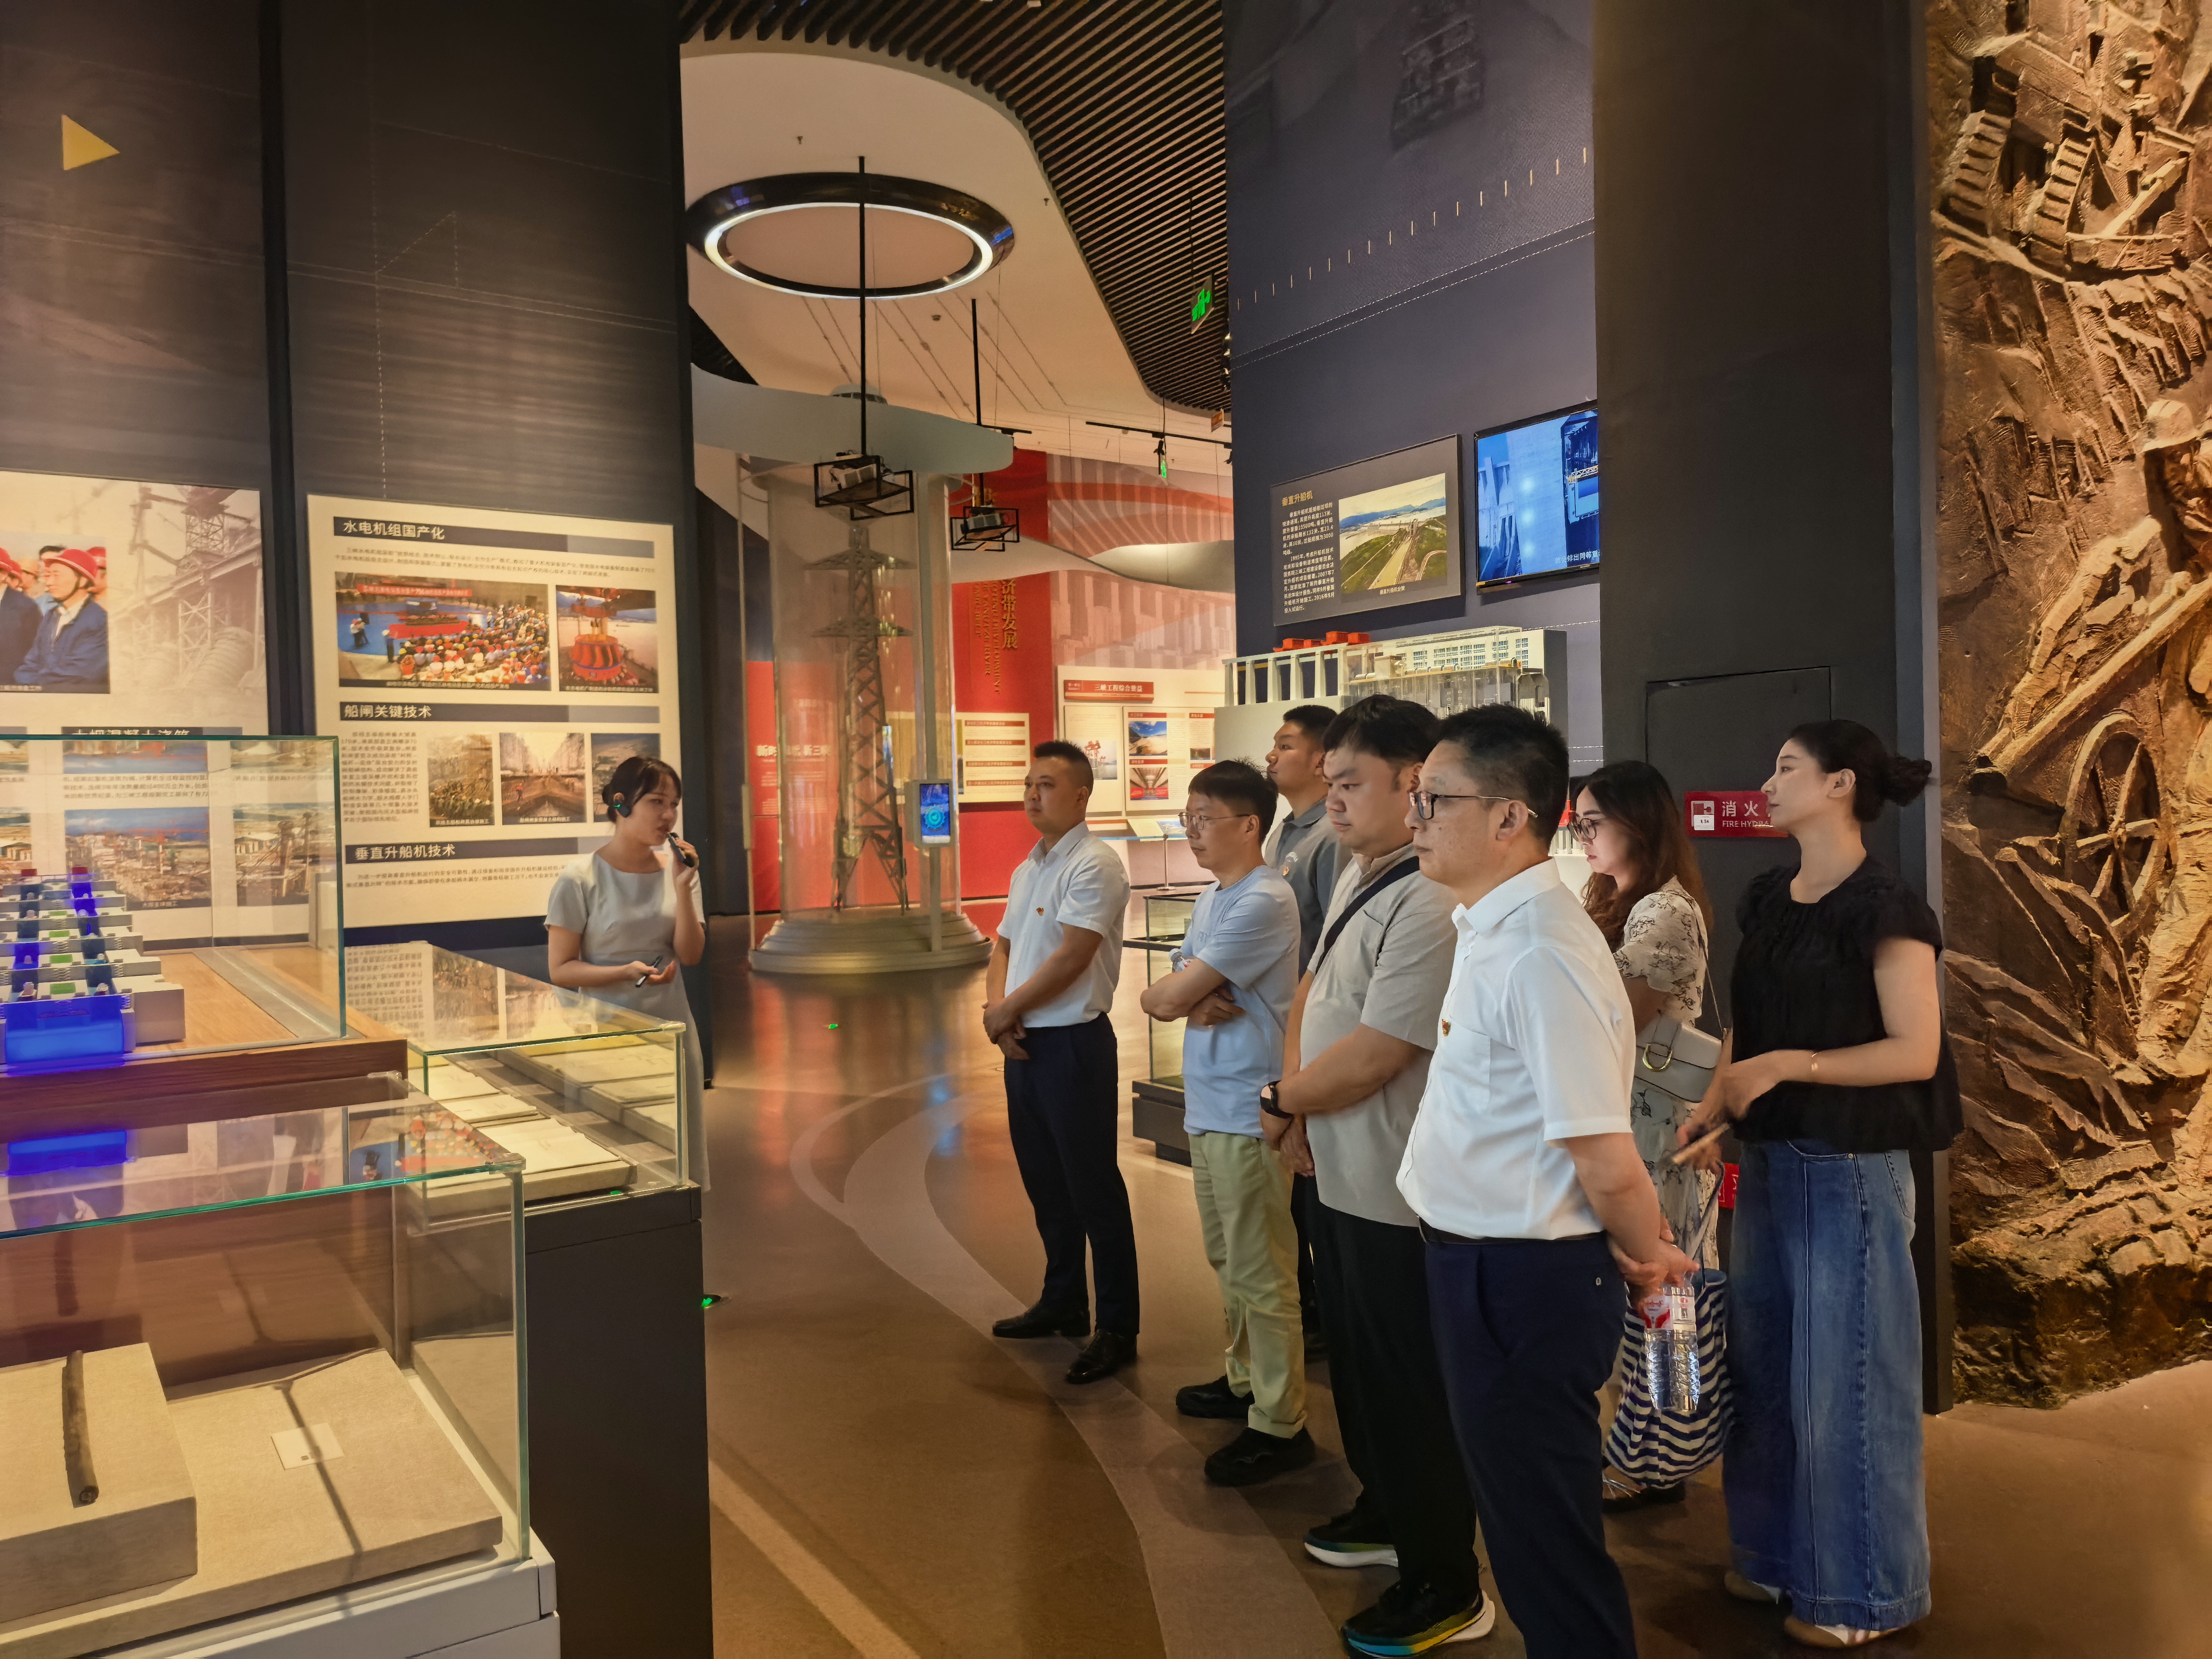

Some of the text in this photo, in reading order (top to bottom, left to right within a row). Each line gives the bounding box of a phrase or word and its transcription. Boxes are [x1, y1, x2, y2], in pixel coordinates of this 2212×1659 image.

[343, 520, 445, 540] 水电机组国产化
[1555, 550, 1600, 564] 就会排出同等重
[1094, 684, 1143, 692] 三峡工程综合效益
[344, 705, 432, 719] 船闸关键技术
[1722, 800, 1771, 817] 消火
[355, 844, 455, 860] 垂直升船机技术
